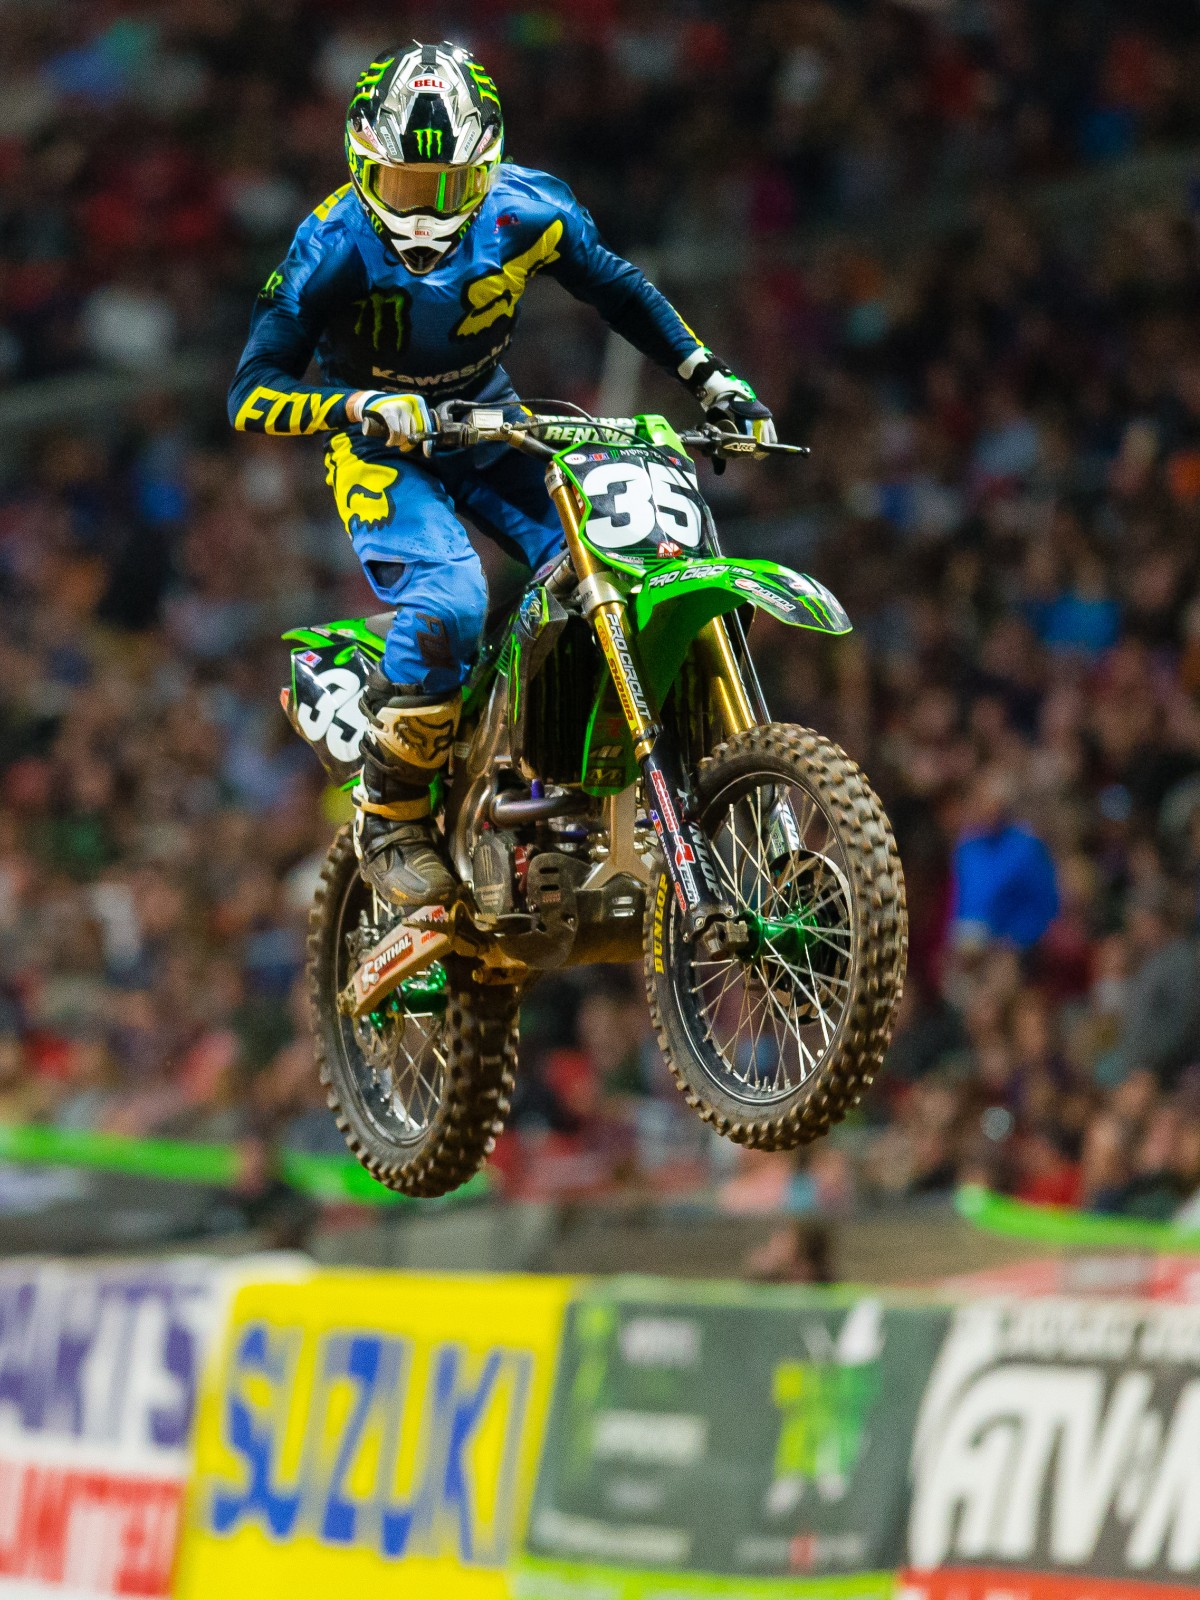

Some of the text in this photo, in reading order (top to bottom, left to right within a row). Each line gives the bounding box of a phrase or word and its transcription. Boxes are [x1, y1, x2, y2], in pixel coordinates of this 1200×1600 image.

[414, 79, 445, 89] BELL
[235, 386, 345, 436] FOX
[582, 462, 702, 548] 35
[649, 570, 680, 588] PRO
[606, 613, 652, 721] PRO CIRCUIT
[608, 657, 634, 721] SHOWA
[654, 873, 668, 974] DUNLOP
[362, 933, 412, 993] RENTHAL
[207, 1322, 533, 1567] SUZUKI
